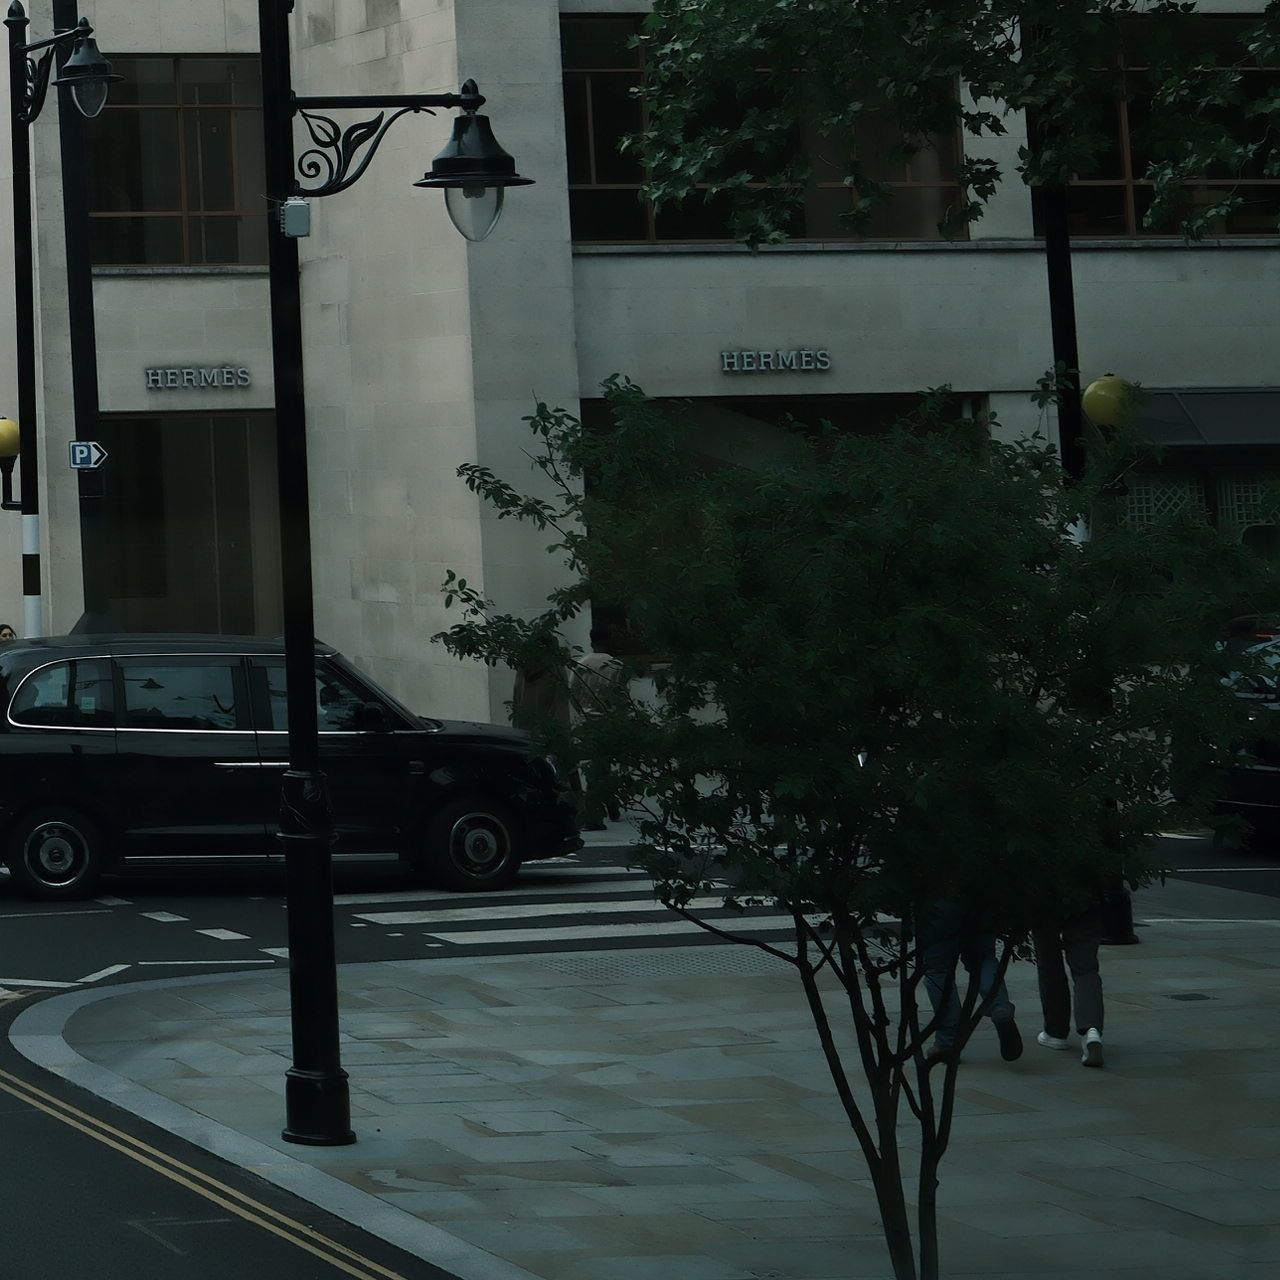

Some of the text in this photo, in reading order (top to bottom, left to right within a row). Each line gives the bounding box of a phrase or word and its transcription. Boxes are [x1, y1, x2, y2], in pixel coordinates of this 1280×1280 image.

[720, 347, 832, 371] HERMÈS
[146, 366, 252, 389] HERMÈS
[75, 446, 88, 463] P
